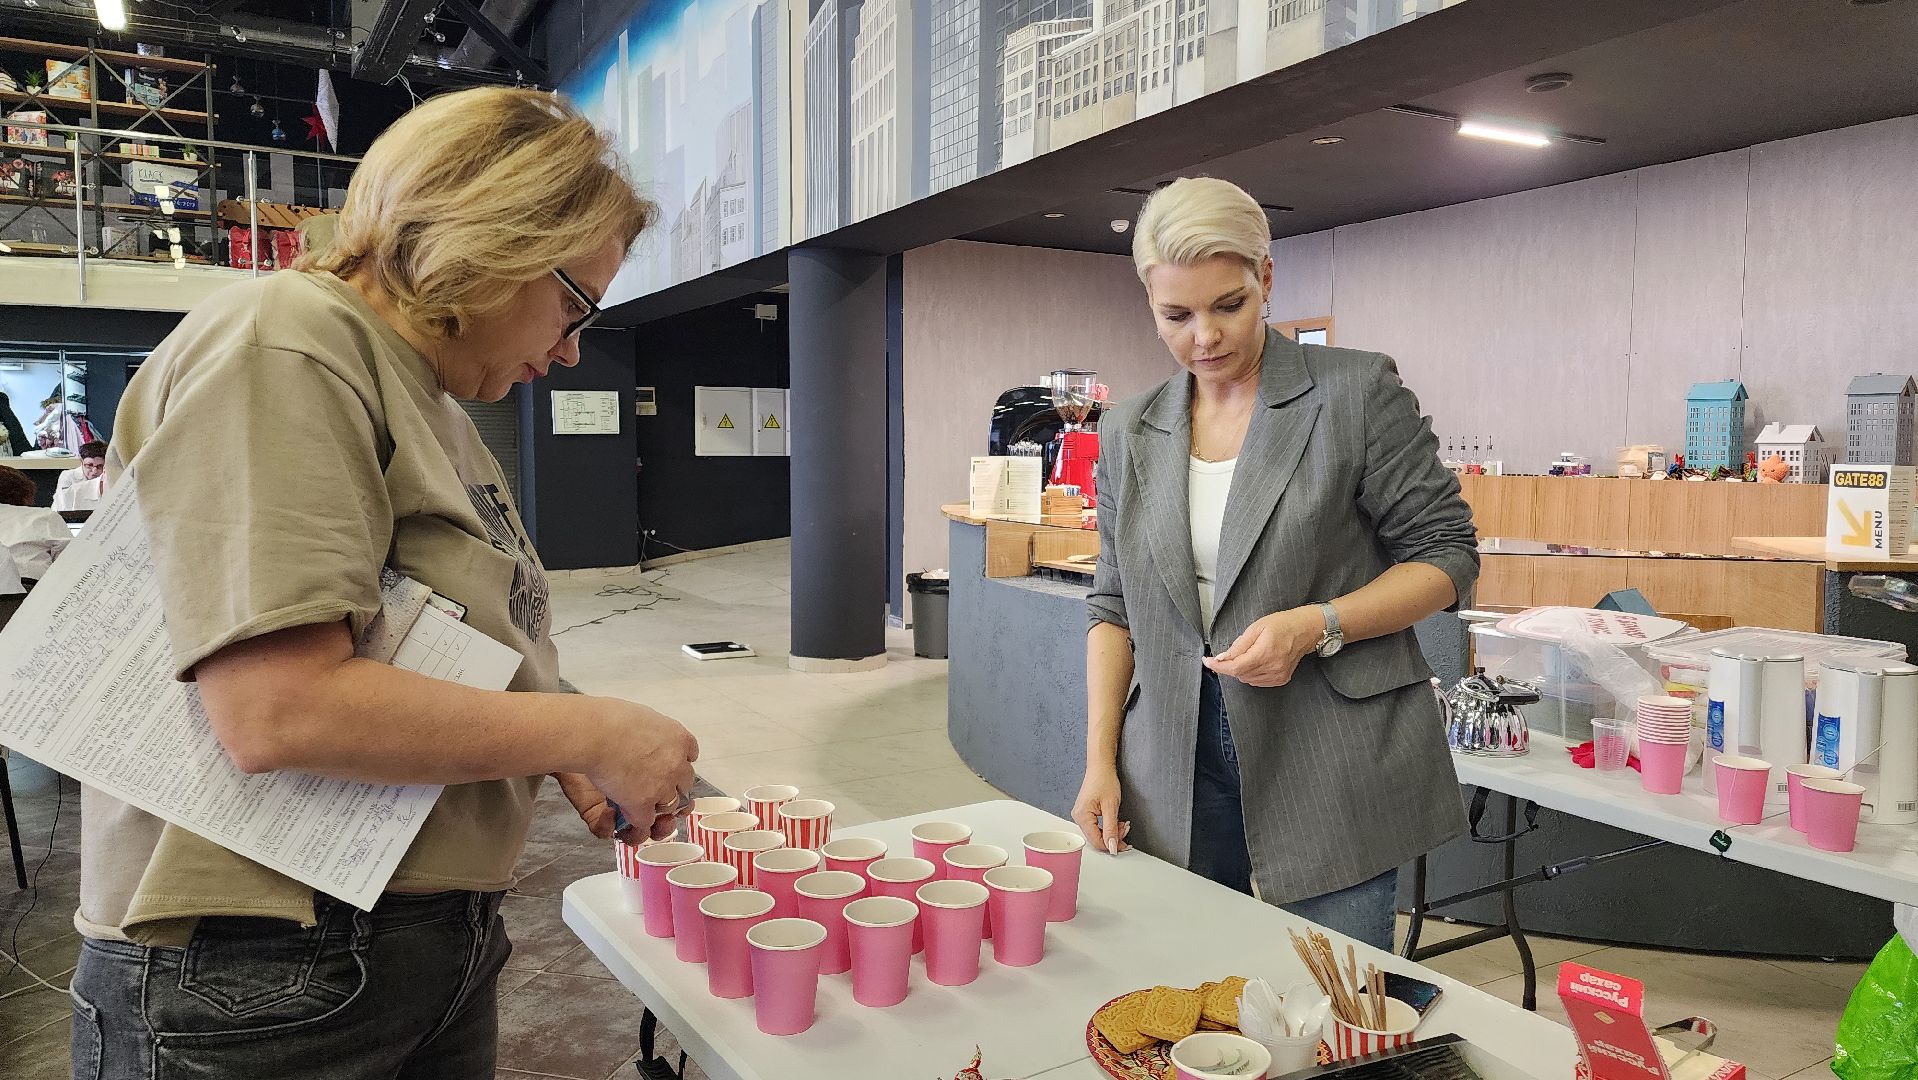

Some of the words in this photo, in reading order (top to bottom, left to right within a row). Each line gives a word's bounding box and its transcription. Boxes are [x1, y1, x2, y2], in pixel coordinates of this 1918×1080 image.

[1835, 472, 1885, 487] GATE88
[1875, 510, 1883, 549] MENU
[1580, 972, 1622, 991] сахар
[1570, 982, 1629, 1008] Русский
